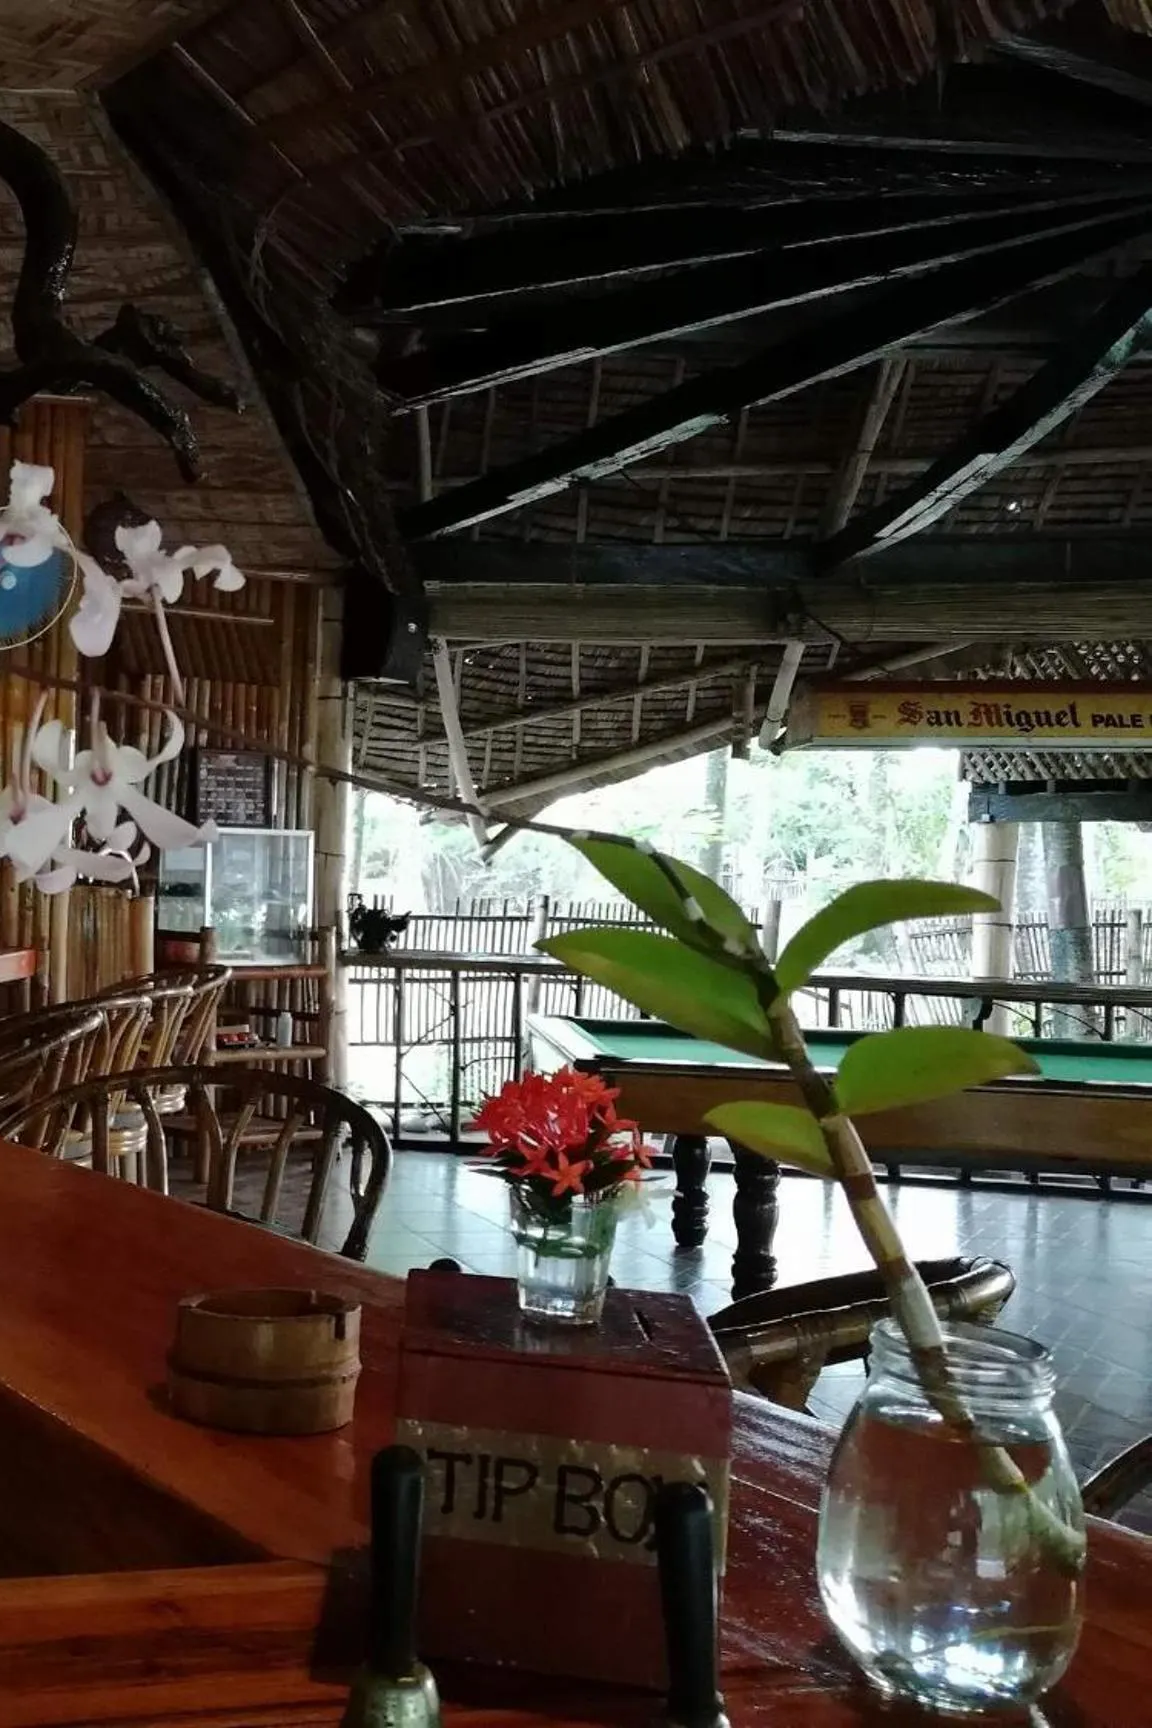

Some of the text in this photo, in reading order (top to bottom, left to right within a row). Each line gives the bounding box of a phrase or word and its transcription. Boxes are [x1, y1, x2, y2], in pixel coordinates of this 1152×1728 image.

[897, 700, 963, 728] San
[967, 700, 1082, 733] Miguel
[1090, 712, 1145, 729] PALE
[427, 1446, 708, 1553] TIP BO
